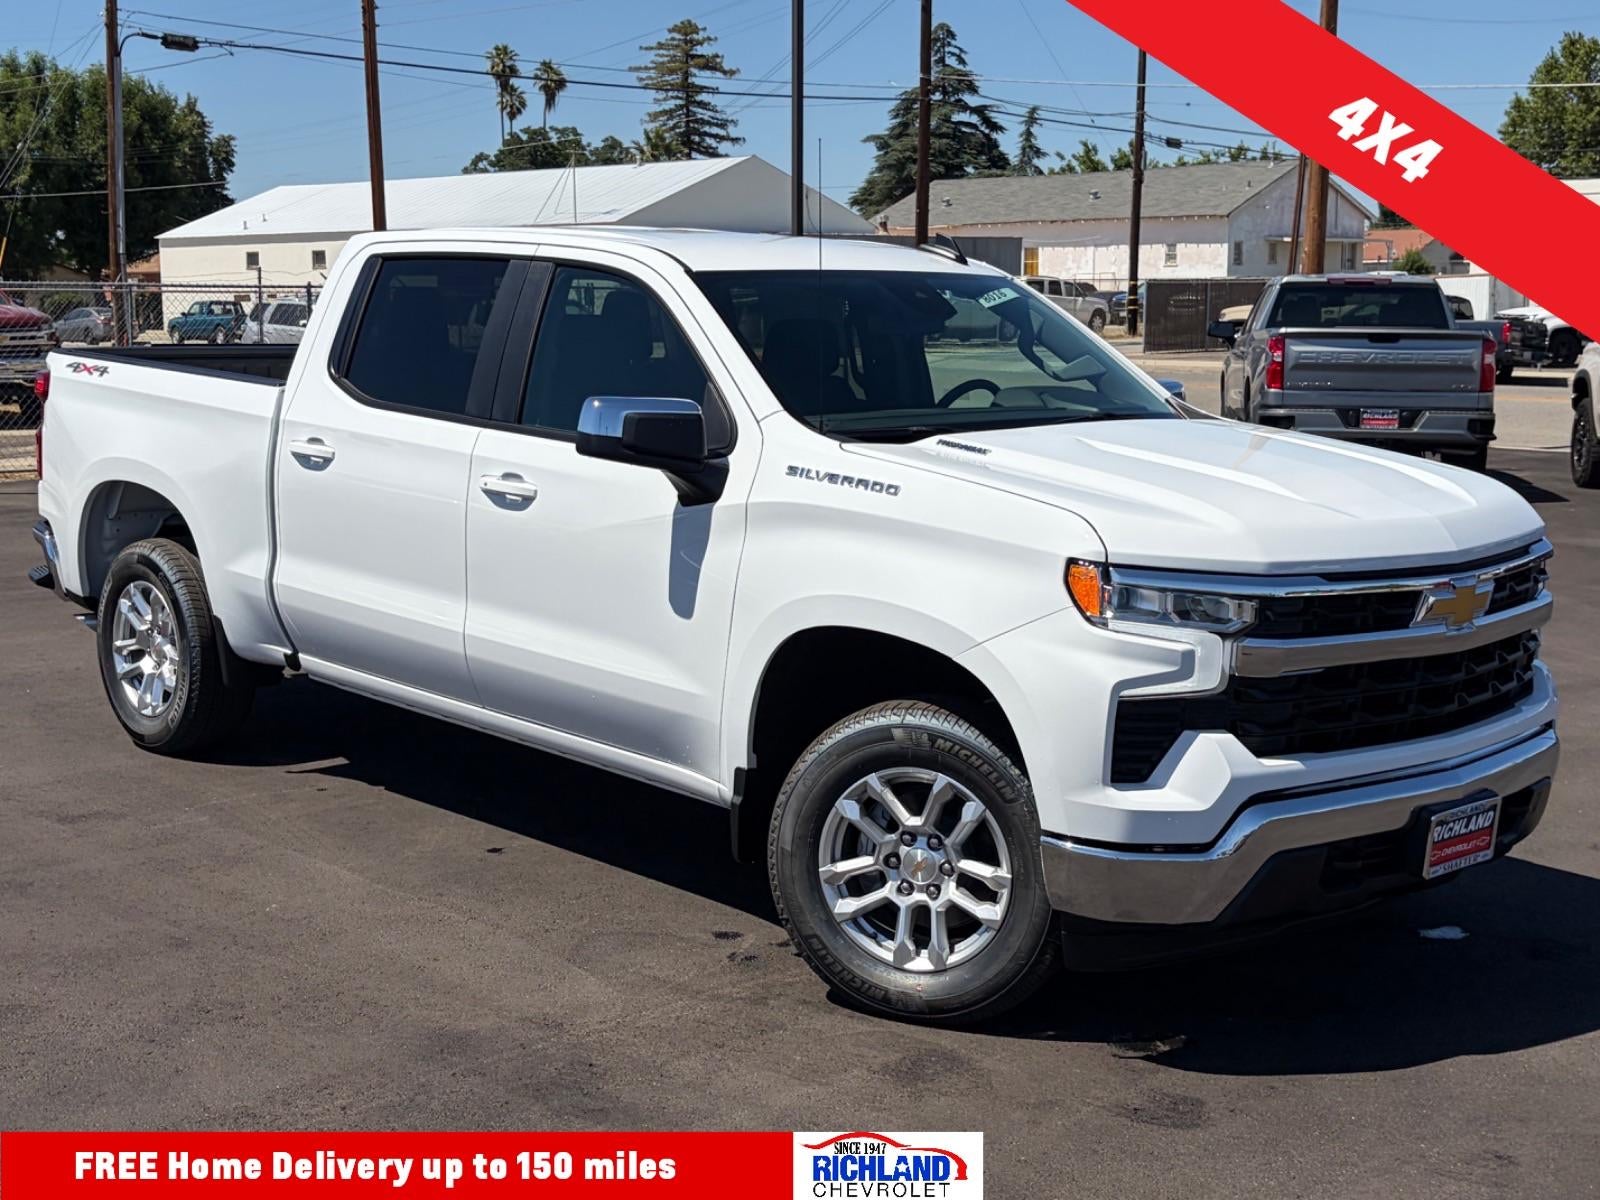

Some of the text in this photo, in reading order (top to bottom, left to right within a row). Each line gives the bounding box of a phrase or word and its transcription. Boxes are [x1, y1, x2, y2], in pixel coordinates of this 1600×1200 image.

[1299, 353, 1471, 364] CHEVROLET
[784, 464, 901, 497] SILVERADO
[934, 738, 1019, 801] MICHELIN
[1432, 810, 1495, 842] RICHLAND
